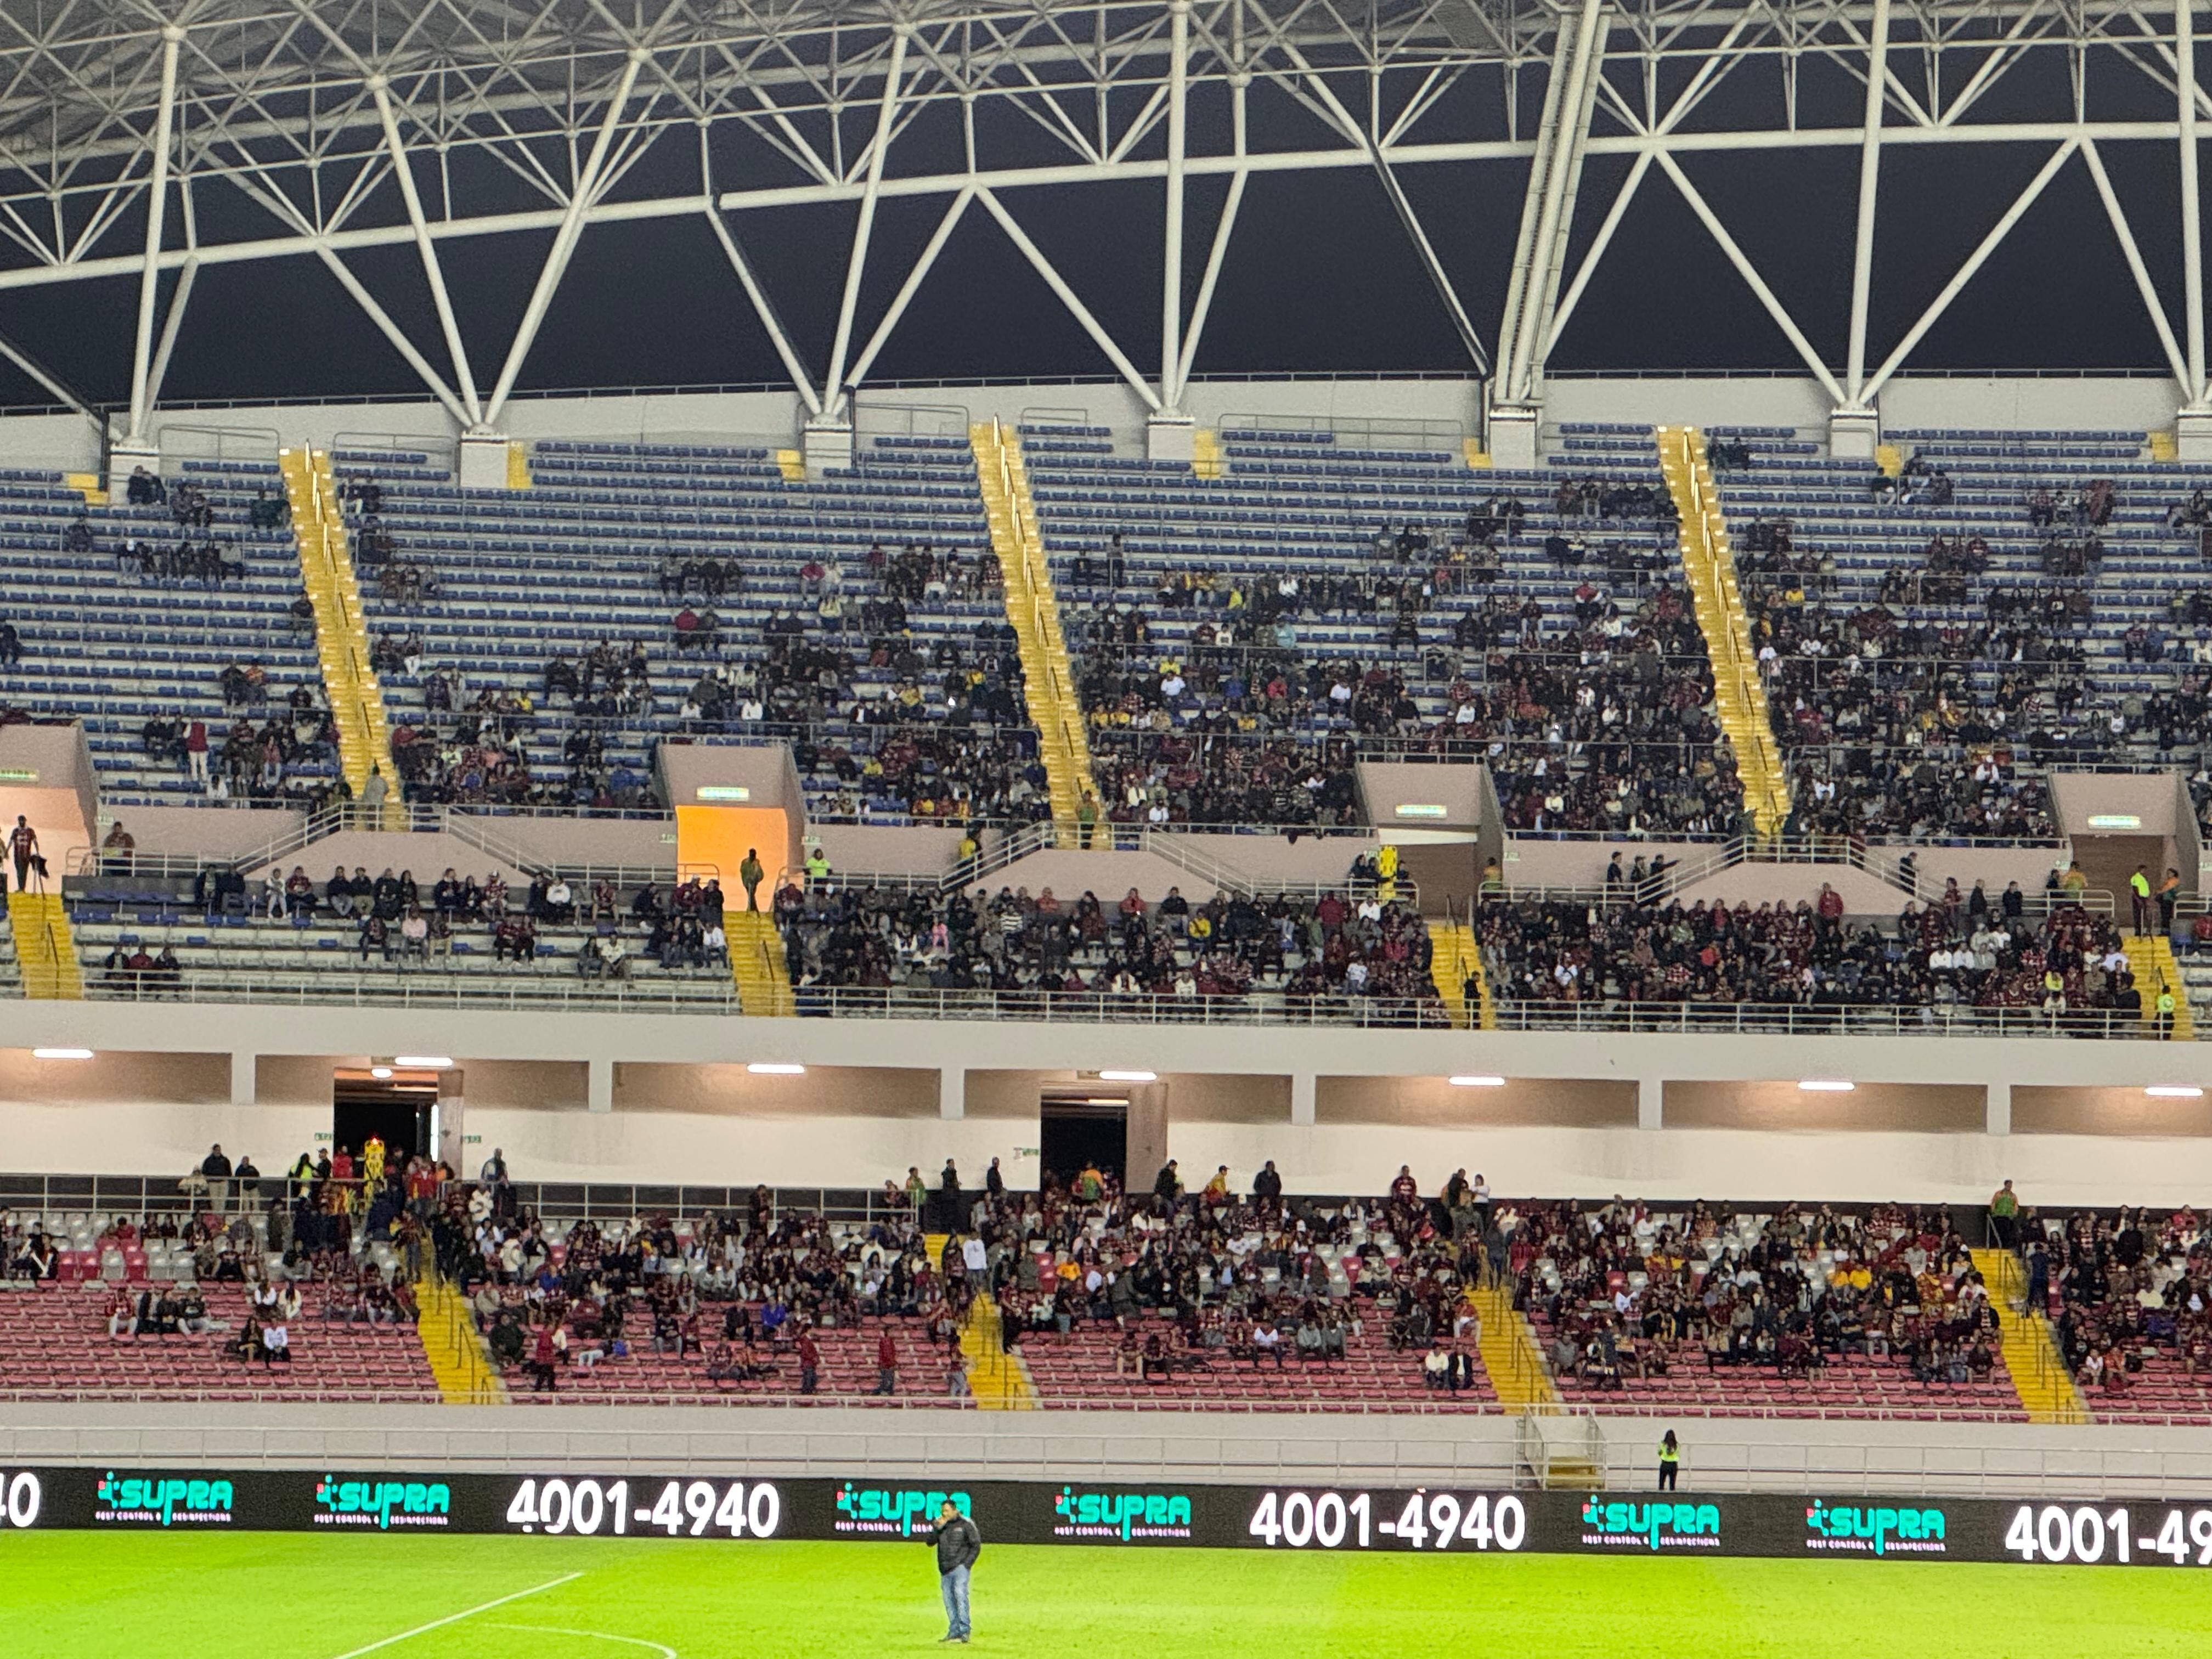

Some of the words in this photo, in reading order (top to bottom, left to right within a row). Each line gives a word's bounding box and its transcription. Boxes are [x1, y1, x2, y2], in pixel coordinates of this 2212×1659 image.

[119, 1479, 233, 1525] SUPRA
[338, 1482, 449, 1529] SUPRA
[507, 1479, 780, 1537] 4001-4940
[859, 1491, 970, 1537] SUPRA
[1078, 1494, 1190, 1541] SUPRA
[1250, 1492, 1525, 1550] 4001-4940
[1606, 1503, 1719, 1550] SUPRA
[1830, 1508, 1945, 1555] SUPRA
